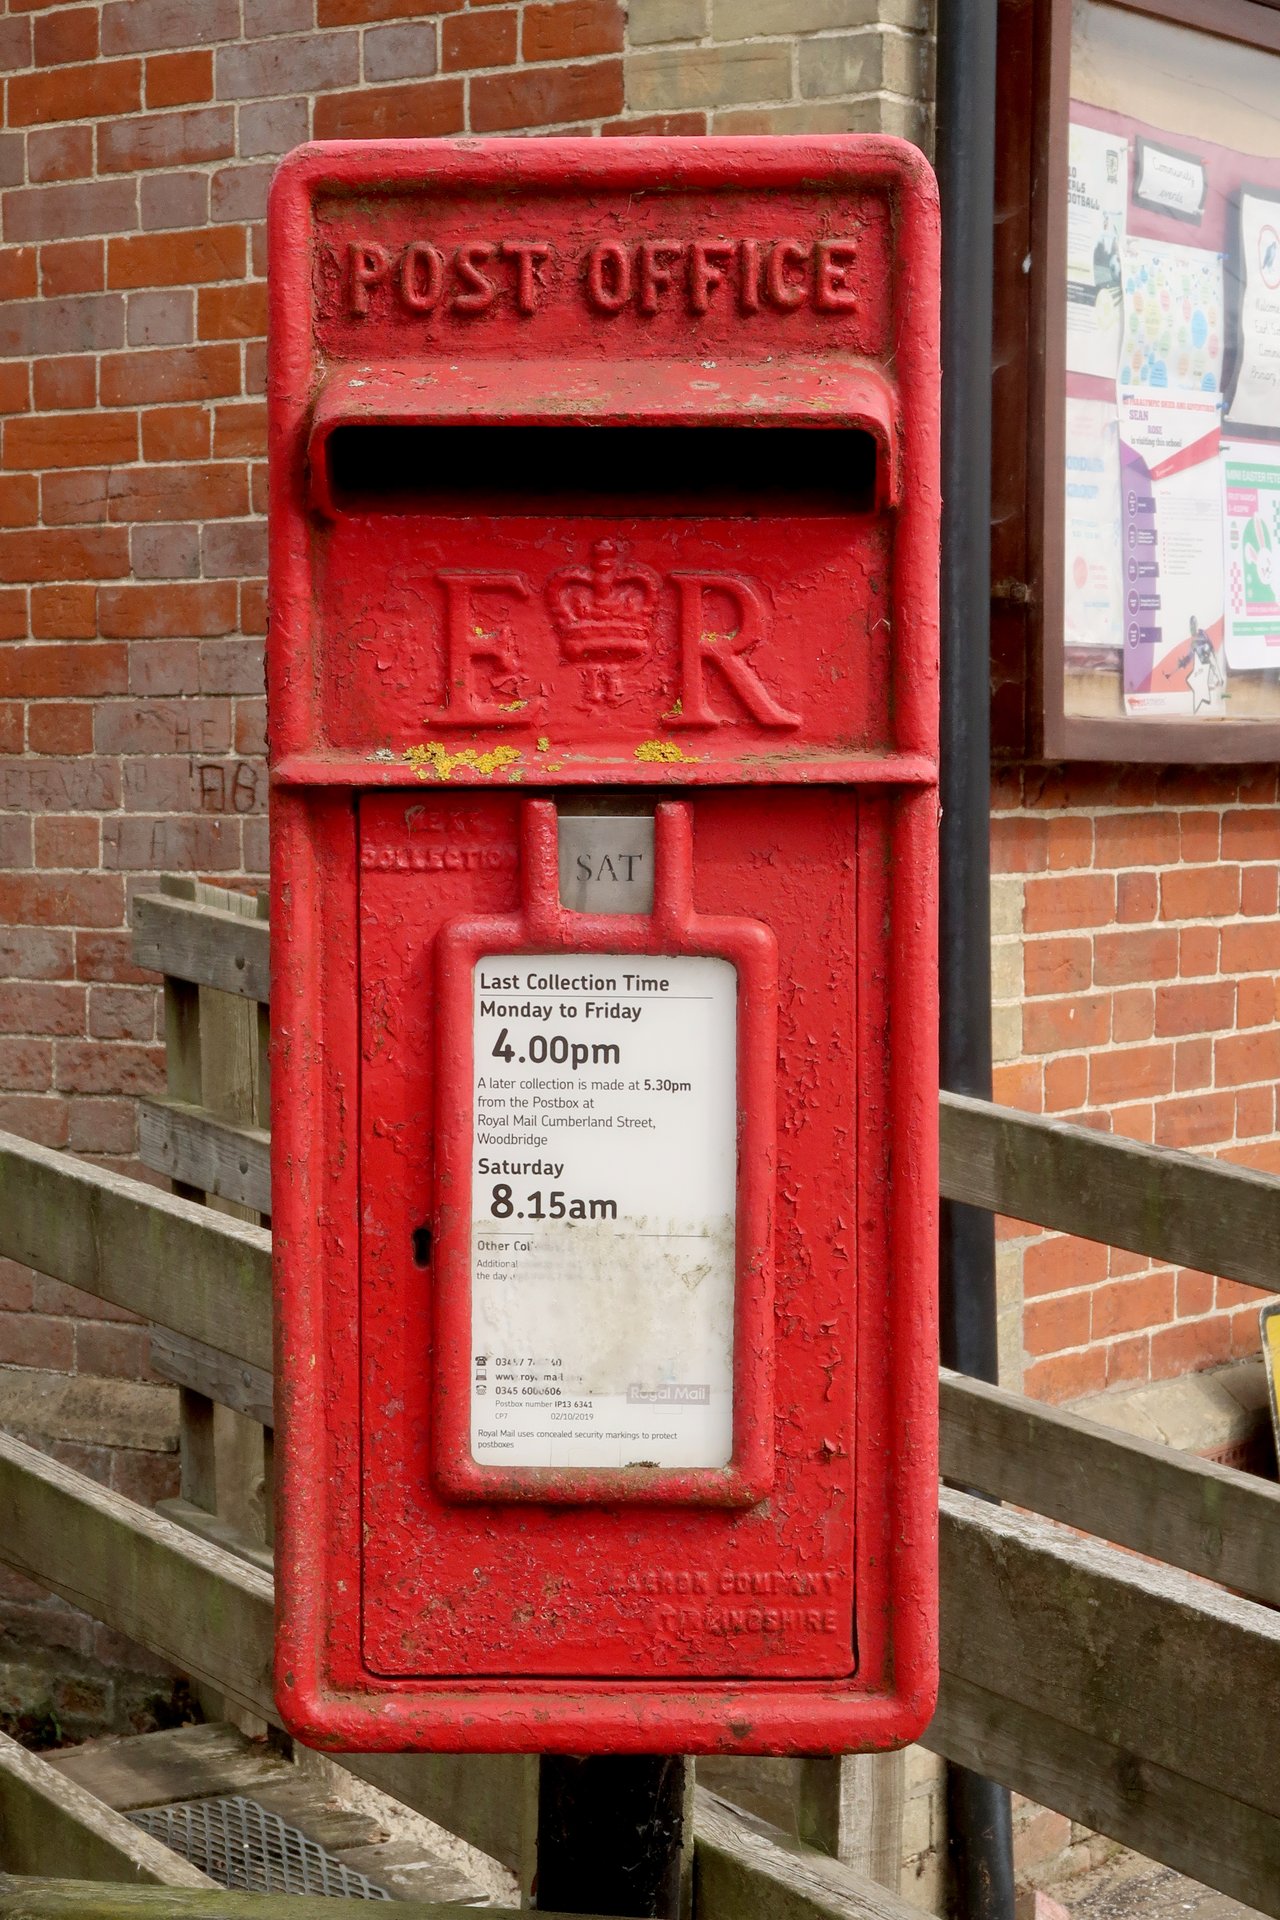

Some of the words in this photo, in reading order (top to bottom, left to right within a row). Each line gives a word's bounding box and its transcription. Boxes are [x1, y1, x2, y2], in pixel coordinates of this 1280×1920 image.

[345, 240, 551, 316] POST
[586, 238, 858, 316] OFFICE
[1129, 410, 1148, 421] SEAN
[1136, 436, 1155, 447] visiting
[424, 567, 545, 730] E
[661, 567, 803, 729] R
[575, 853, 644, 883] SAT
[481, 973, 520, 989] Last
[527, 973, 616, 990] Collection
[622, 975, 669, 991] Time
[481, 1001, 553, 1021] Monday
[559, 1003, 577, 1018] to
[586, 1002, 641, 1022] Friday
[492, 1028, 619, 1070] 4.00pm
[478, 1077, 486, 1088] A
[490, 1078, 516, 1089] later
[520, 1078, 573, 1089] collection
[579, 1078, 587, 1090] is
[591, 1079, 624, 1090] made
[628, 1081, 640, 1090] at
[644, 1079, 691, 1093] 5.30pm
[478, 1096, 505, 1107] from
[510, 1097, 528, 1108] the
[533, 1096, 578, 1108] Postbox
[583, 1099, 594, 1108] at
[478, 1114, 508, 1128] Royal
[514, 1115, 537, 1126] Mail
[542, 1115, 612, 1127] Cumberland
[617, 1116, 655, 1129] Street,
[477, 1133, 547, 1147] Woodbridge
[479, 1158, 564, 1179] Saturday
[491, 1184, 617, 1221] 8.15am
[477, 1241, 510, 1251] Other
[477, 1272, 490, 1280] the
[493, 1272, 507, 1281] day
[496, 1386, 518, 1395] 0345
[674, 1389, 706, 1401] Mail
[478, 1429, 497, 1438] Royal
[606, 1432, 639, 1440] markings
